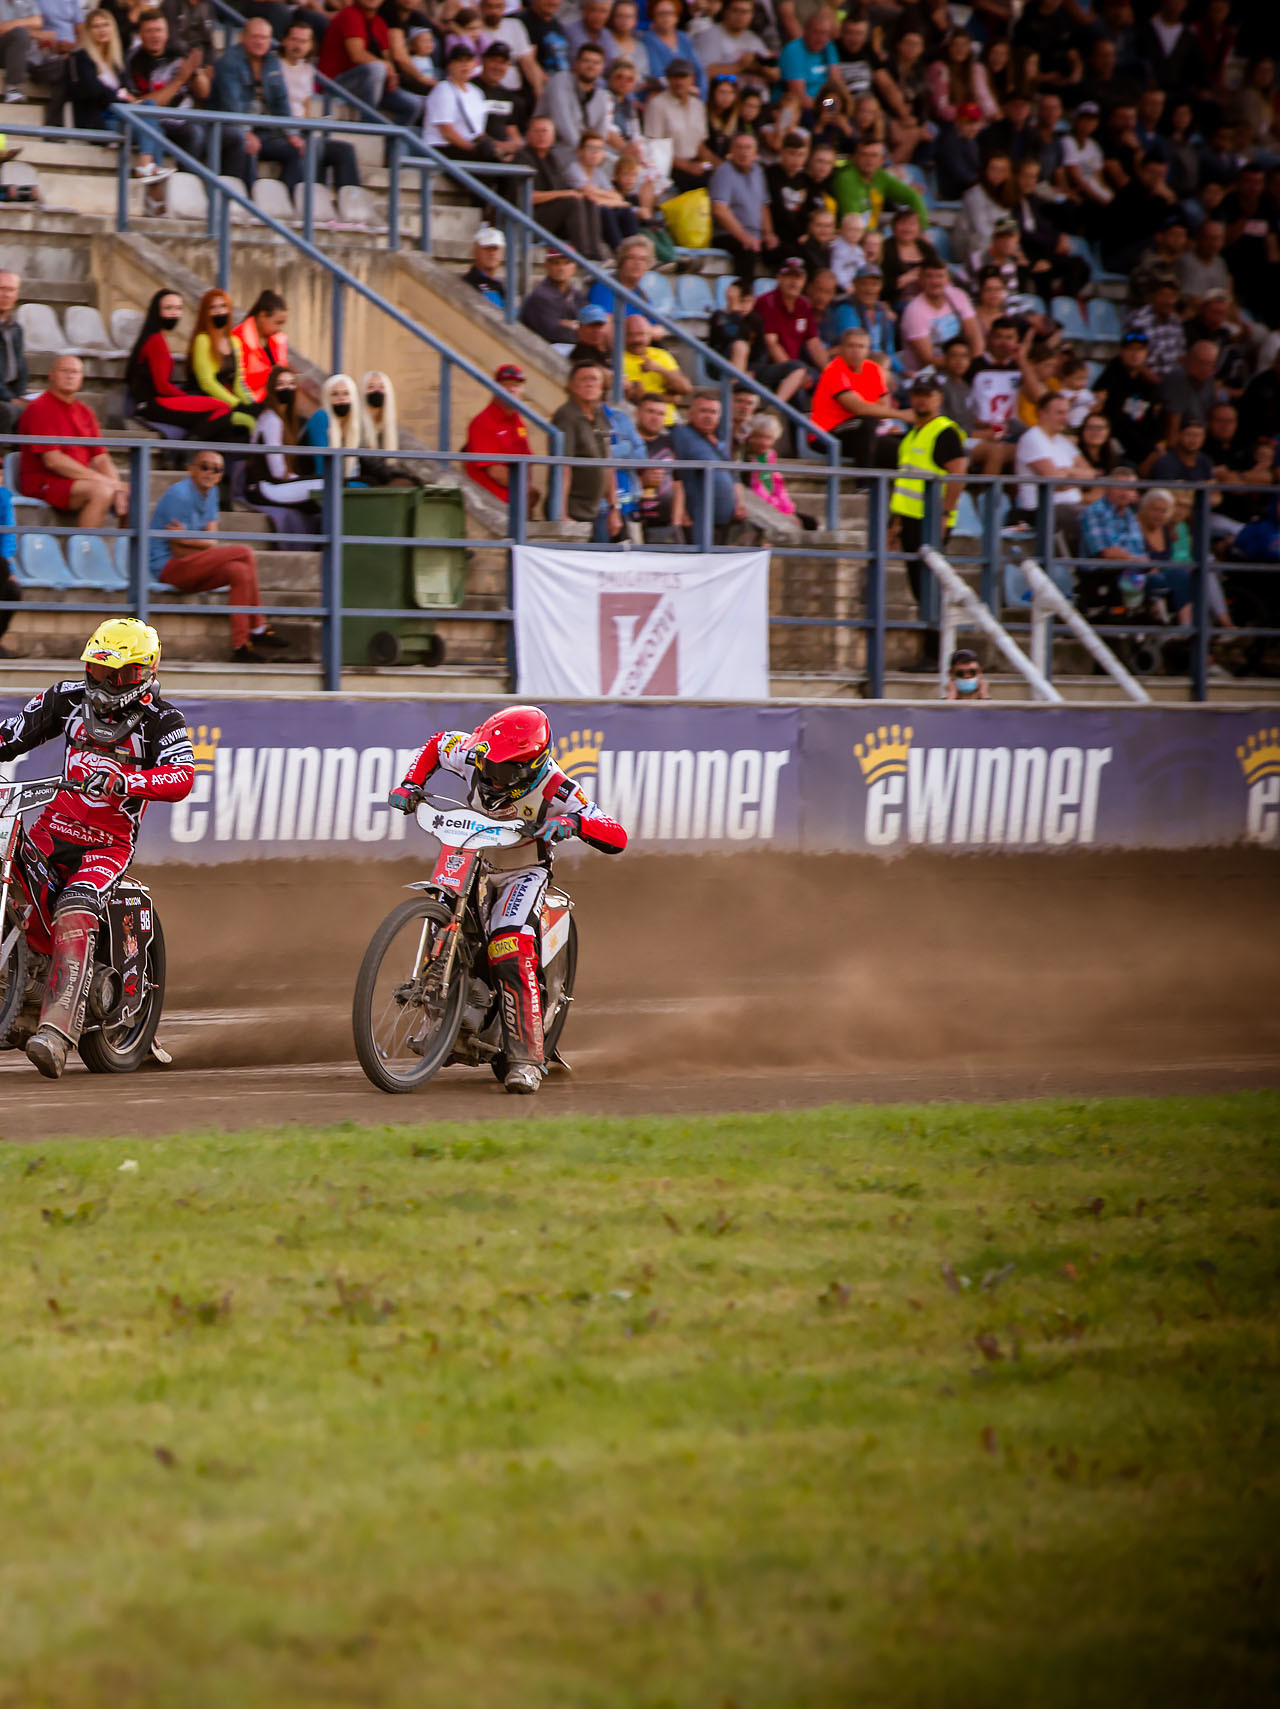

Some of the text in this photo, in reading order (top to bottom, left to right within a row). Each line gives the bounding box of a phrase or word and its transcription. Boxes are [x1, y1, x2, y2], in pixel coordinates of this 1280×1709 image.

[152, 769, 189, 786] AFORTI
[865, 746, 1113, 846] ewinner
[445, 819, 502, 836] cellfast
[140, 910, 150, 930] 98
